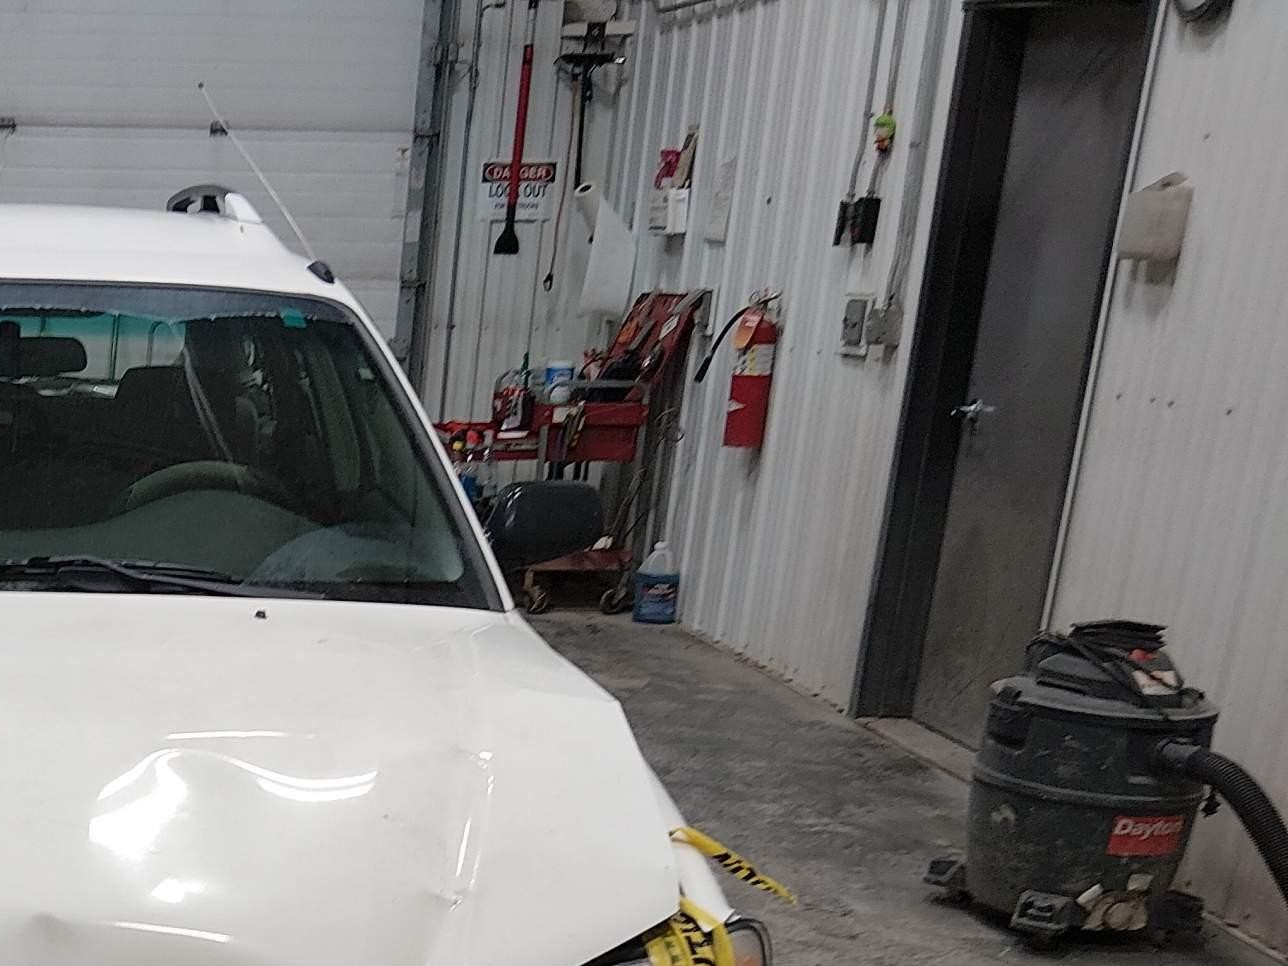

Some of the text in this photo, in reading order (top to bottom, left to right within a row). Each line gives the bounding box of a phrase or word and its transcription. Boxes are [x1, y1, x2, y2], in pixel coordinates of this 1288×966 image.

[493, 166, 548, 179] DAGER
[488, 183, 549, 198] LOC OUT
